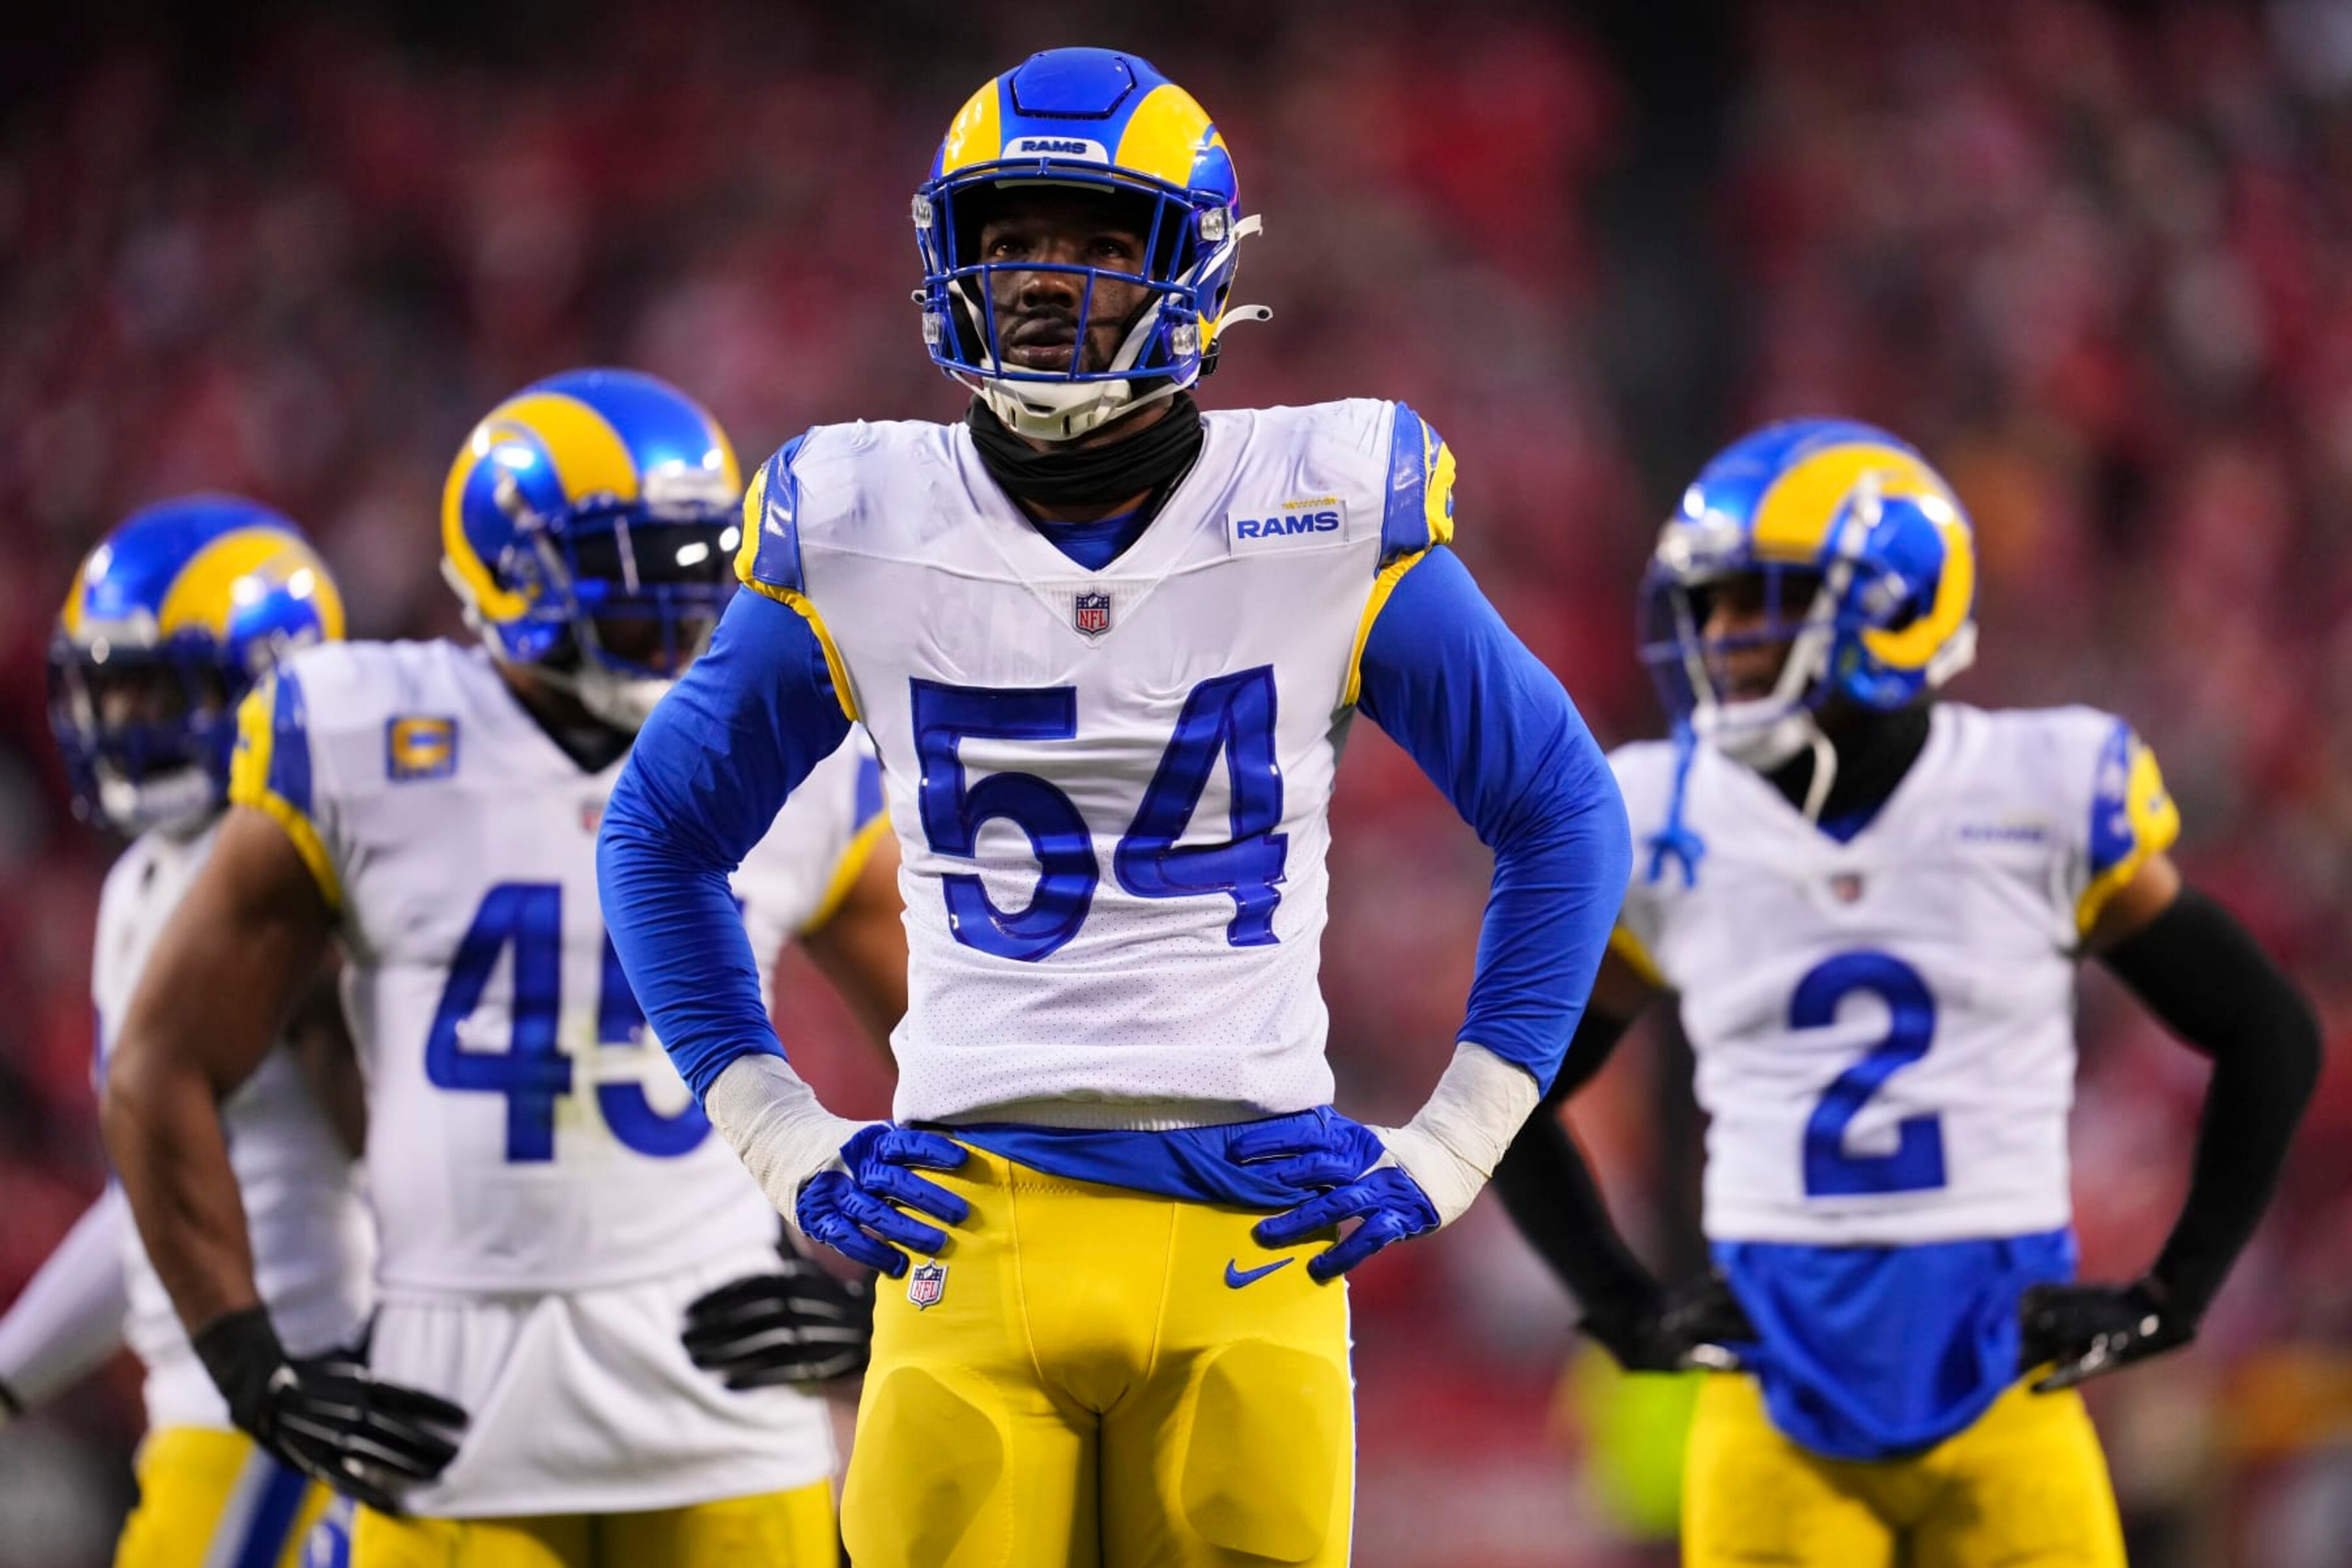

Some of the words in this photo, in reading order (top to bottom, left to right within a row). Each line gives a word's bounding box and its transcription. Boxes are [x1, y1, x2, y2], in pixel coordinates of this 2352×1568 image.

[1021, 140, 1087, 154] RAMS
[1237, 511, 1339, 539] RAMS
[1079, 609, 1107, 629] NFL
[909, 663, 1289, 963] 54
[1789, 948, 1948, 1198] 2
[913, 1281, 937, 1300] NFL
